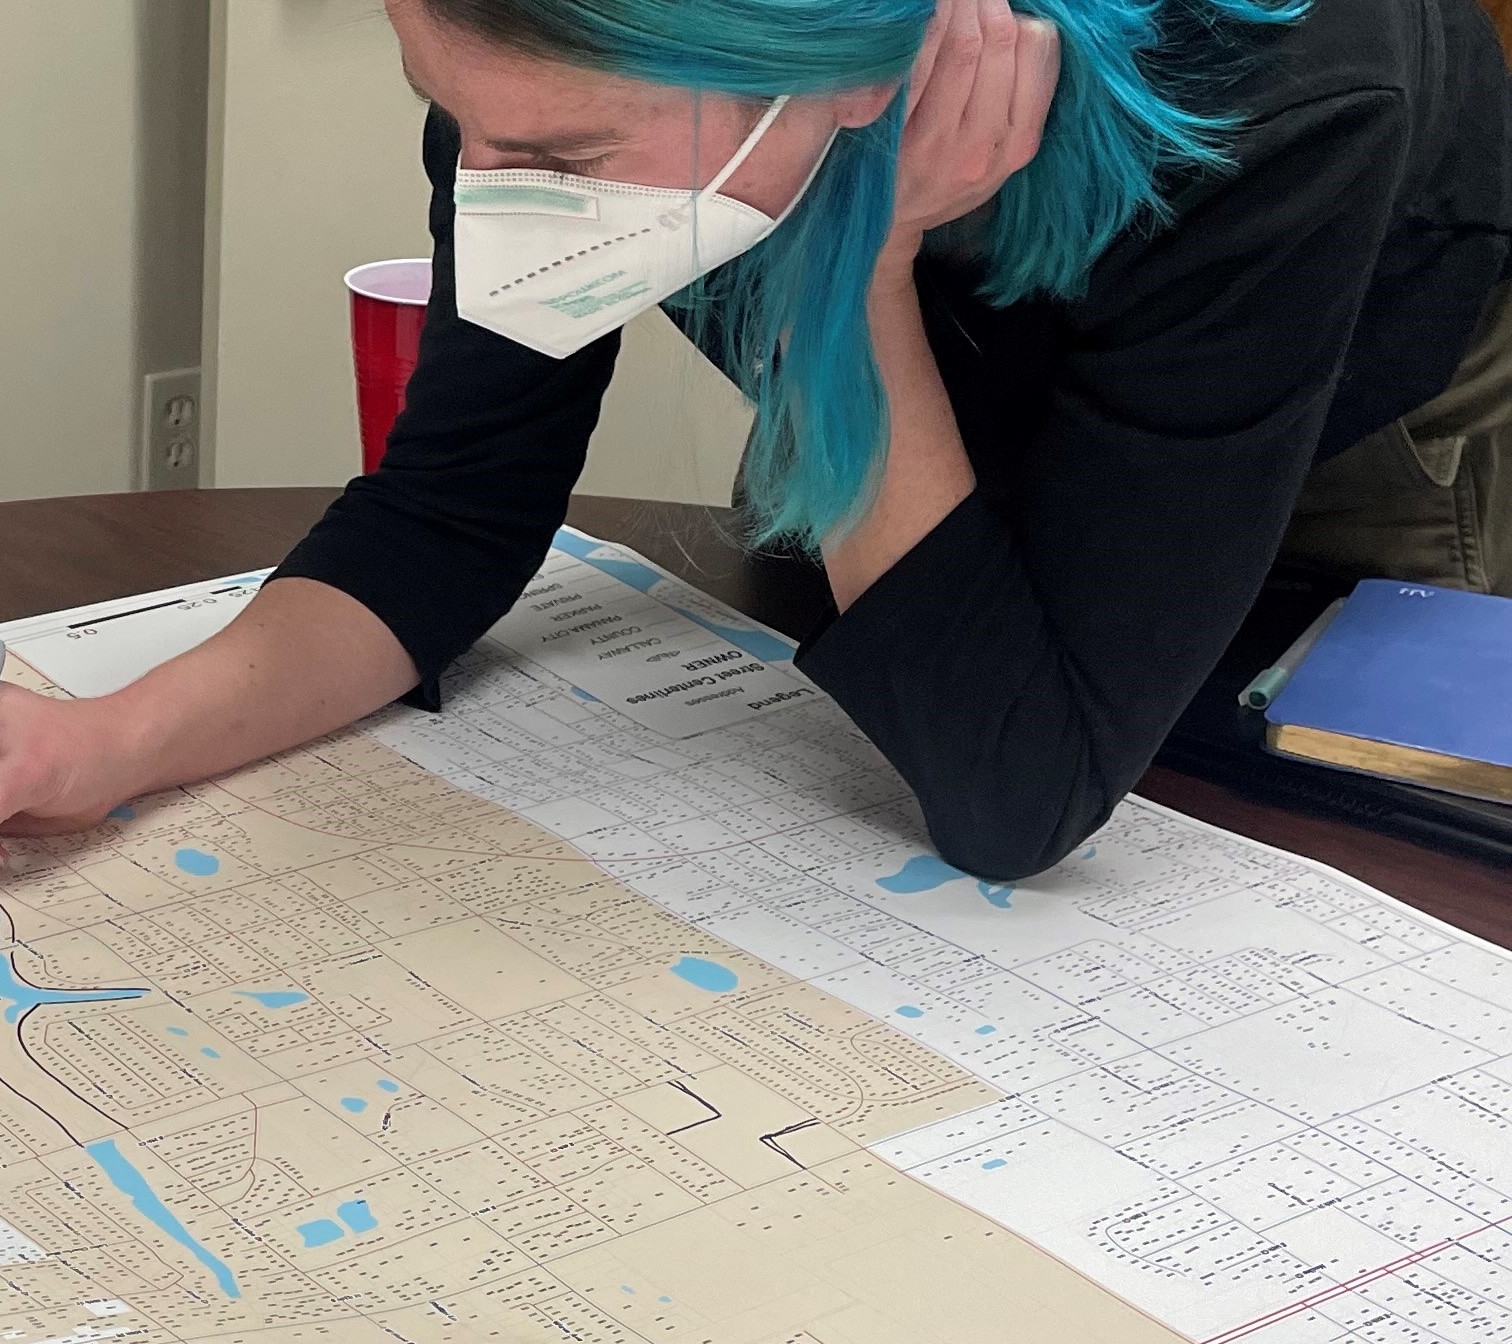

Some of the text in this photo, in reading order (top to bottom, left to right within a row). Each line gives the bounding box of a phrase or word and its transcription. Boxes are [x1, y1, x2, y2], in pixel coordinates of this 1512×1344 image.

[530, 593, 583, 611] PRIVATE
[550, 603, 603, 622] PARKER
[66, 628, 98, 640] 0.5
[542, 614, 623, 643] PANAMA CITY
[590, 626, 642, 645] COUNTY
[598, 637, 662, 660] CALLAWAY
[681, 650, 743, 672] OWNER
[626, 663, 765, 705] Street Centerlines
[747, 687, 816, 711] Legend
